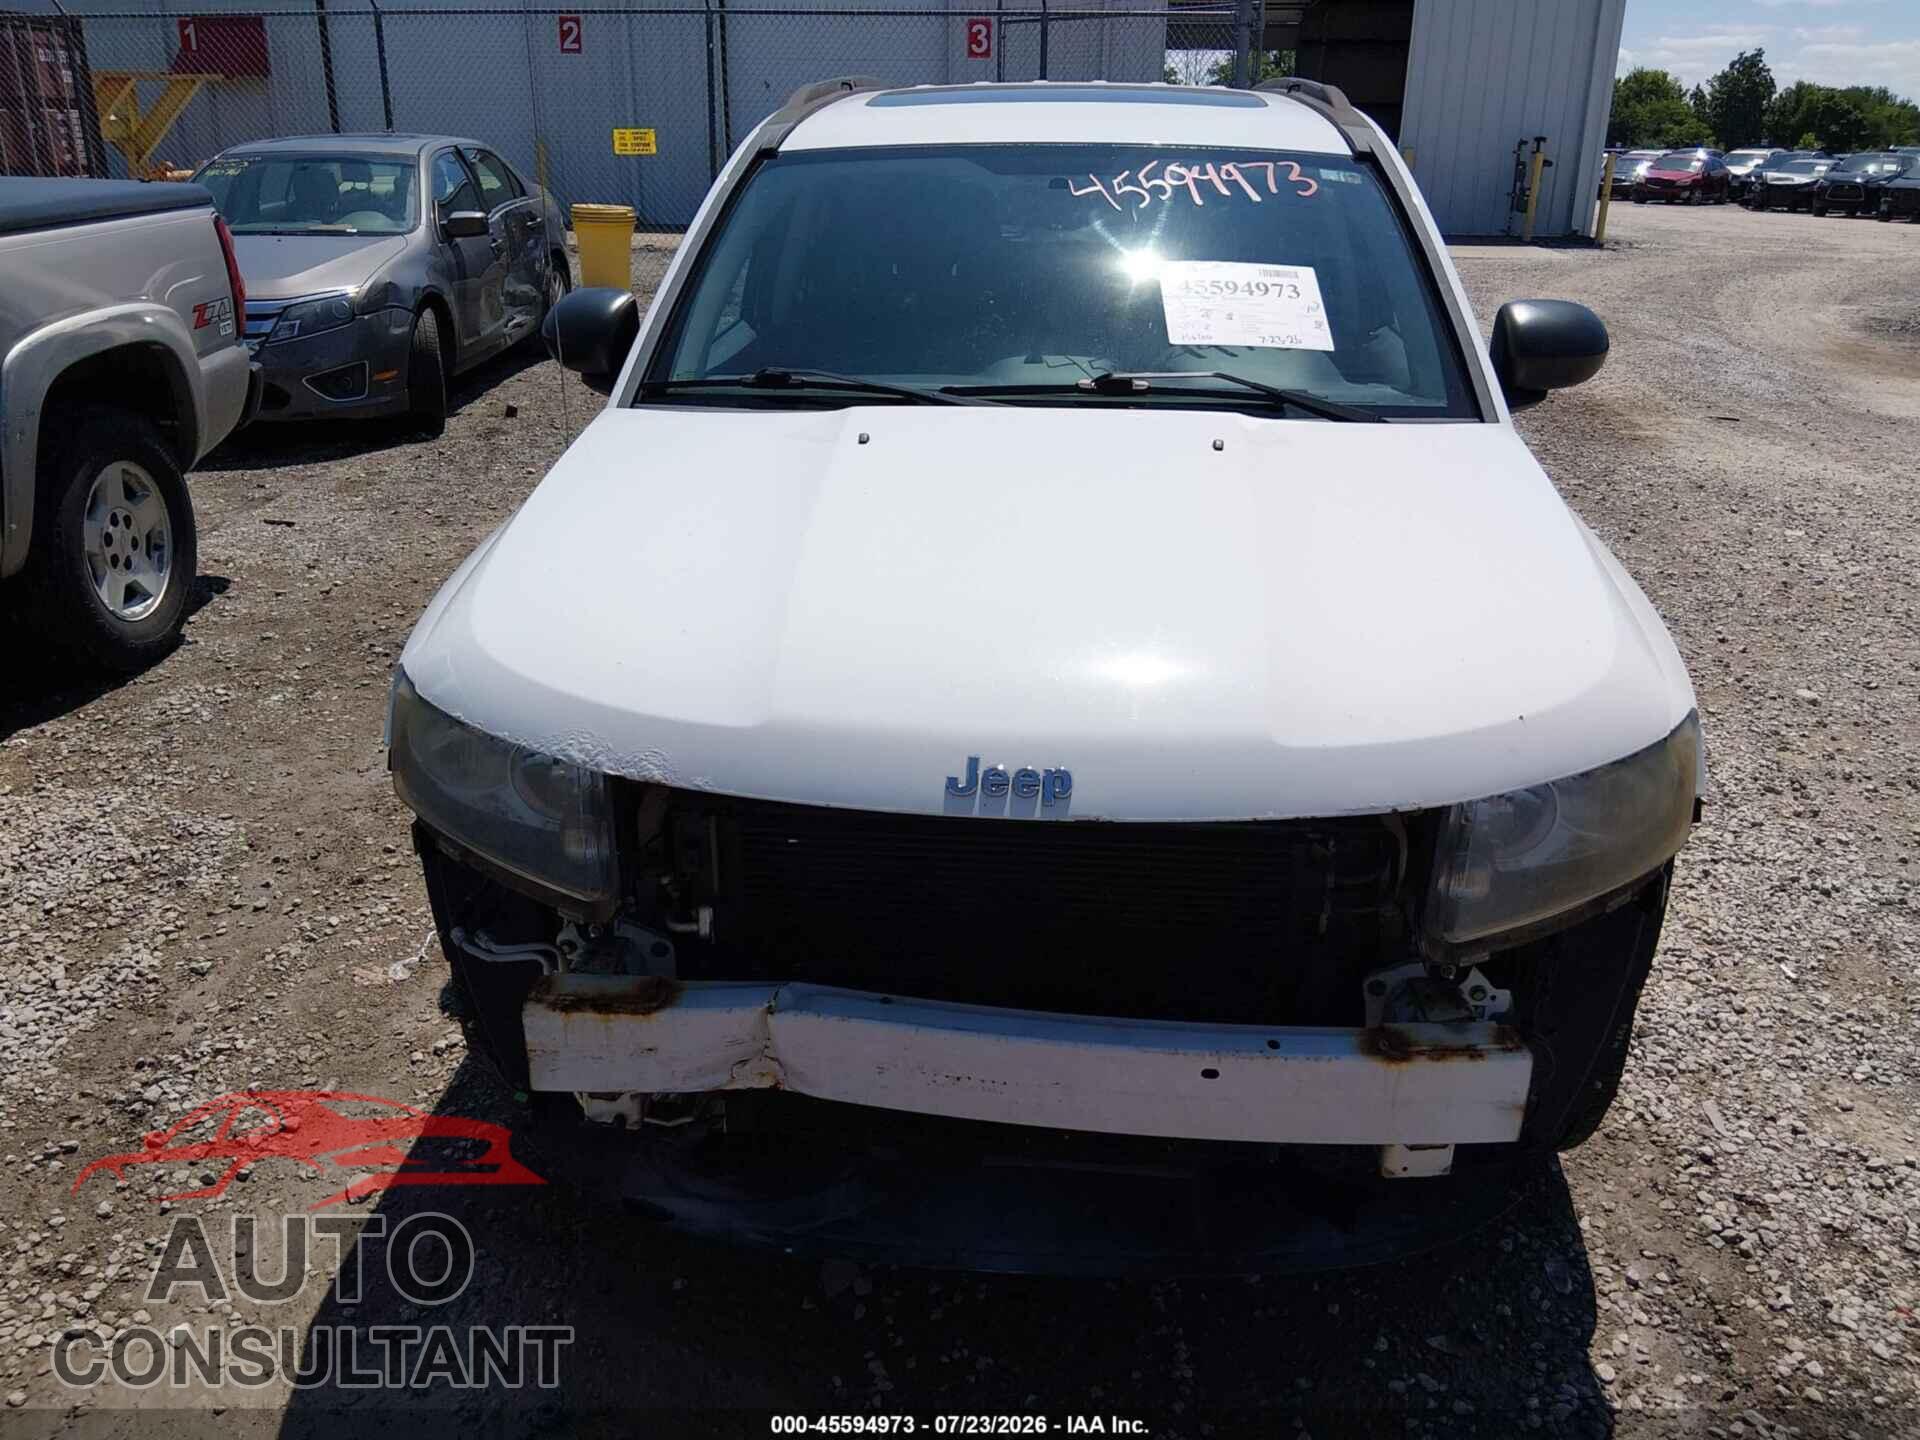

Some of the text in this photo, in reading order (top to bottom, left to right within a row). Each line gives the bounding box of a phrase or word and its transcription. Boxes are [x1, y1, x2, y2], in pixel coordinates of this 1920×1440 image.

[184, 23, 198, 51] 1
[562, 21, 580, 49] 2
[971, 23, 989, 54] 3
[1068, 160, 1318, 212] 45594973
[945, 756, 1073, 806] Jeep
